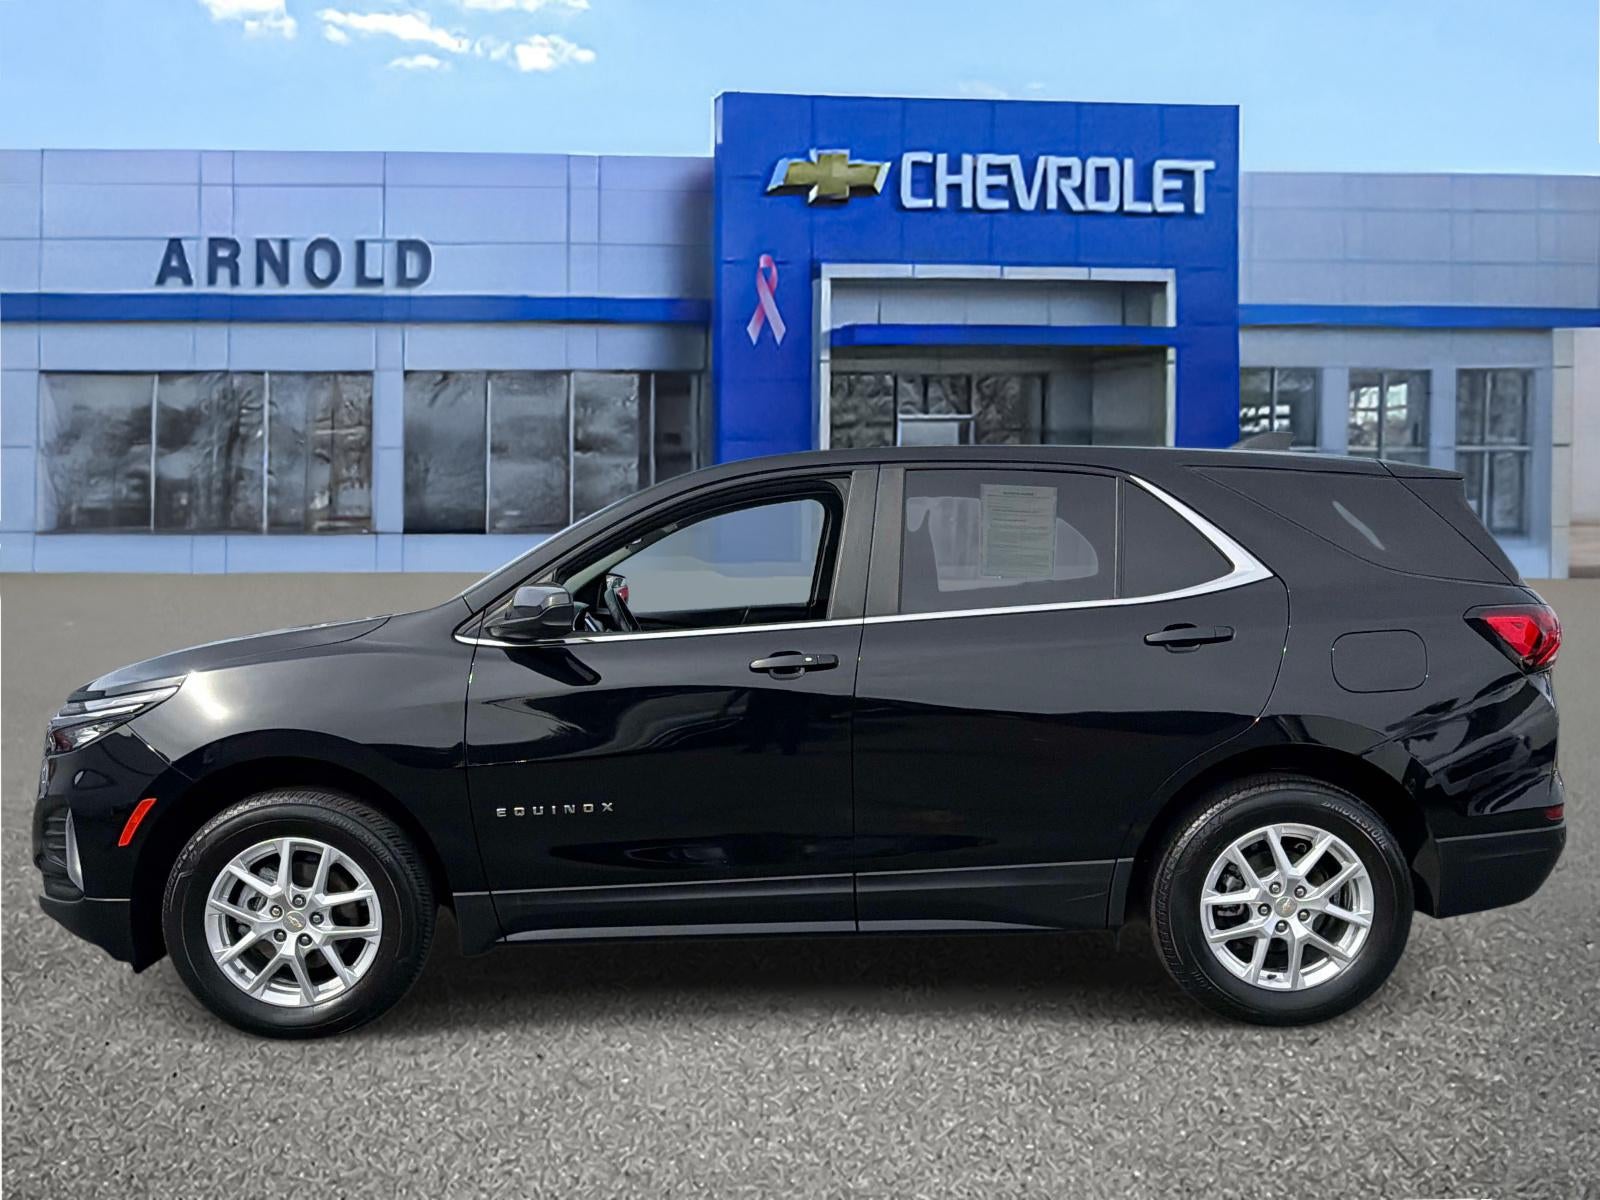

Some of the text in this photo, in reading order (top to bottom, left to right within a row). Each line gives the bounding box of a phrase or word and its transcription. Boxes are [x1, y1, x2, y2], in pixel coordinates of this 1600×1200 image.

[900, 151, 1216, 215] CHEVROLET
[155, 237, 433, 288] ARNOLD
[496, 802, 614, 817] EQUINOX
